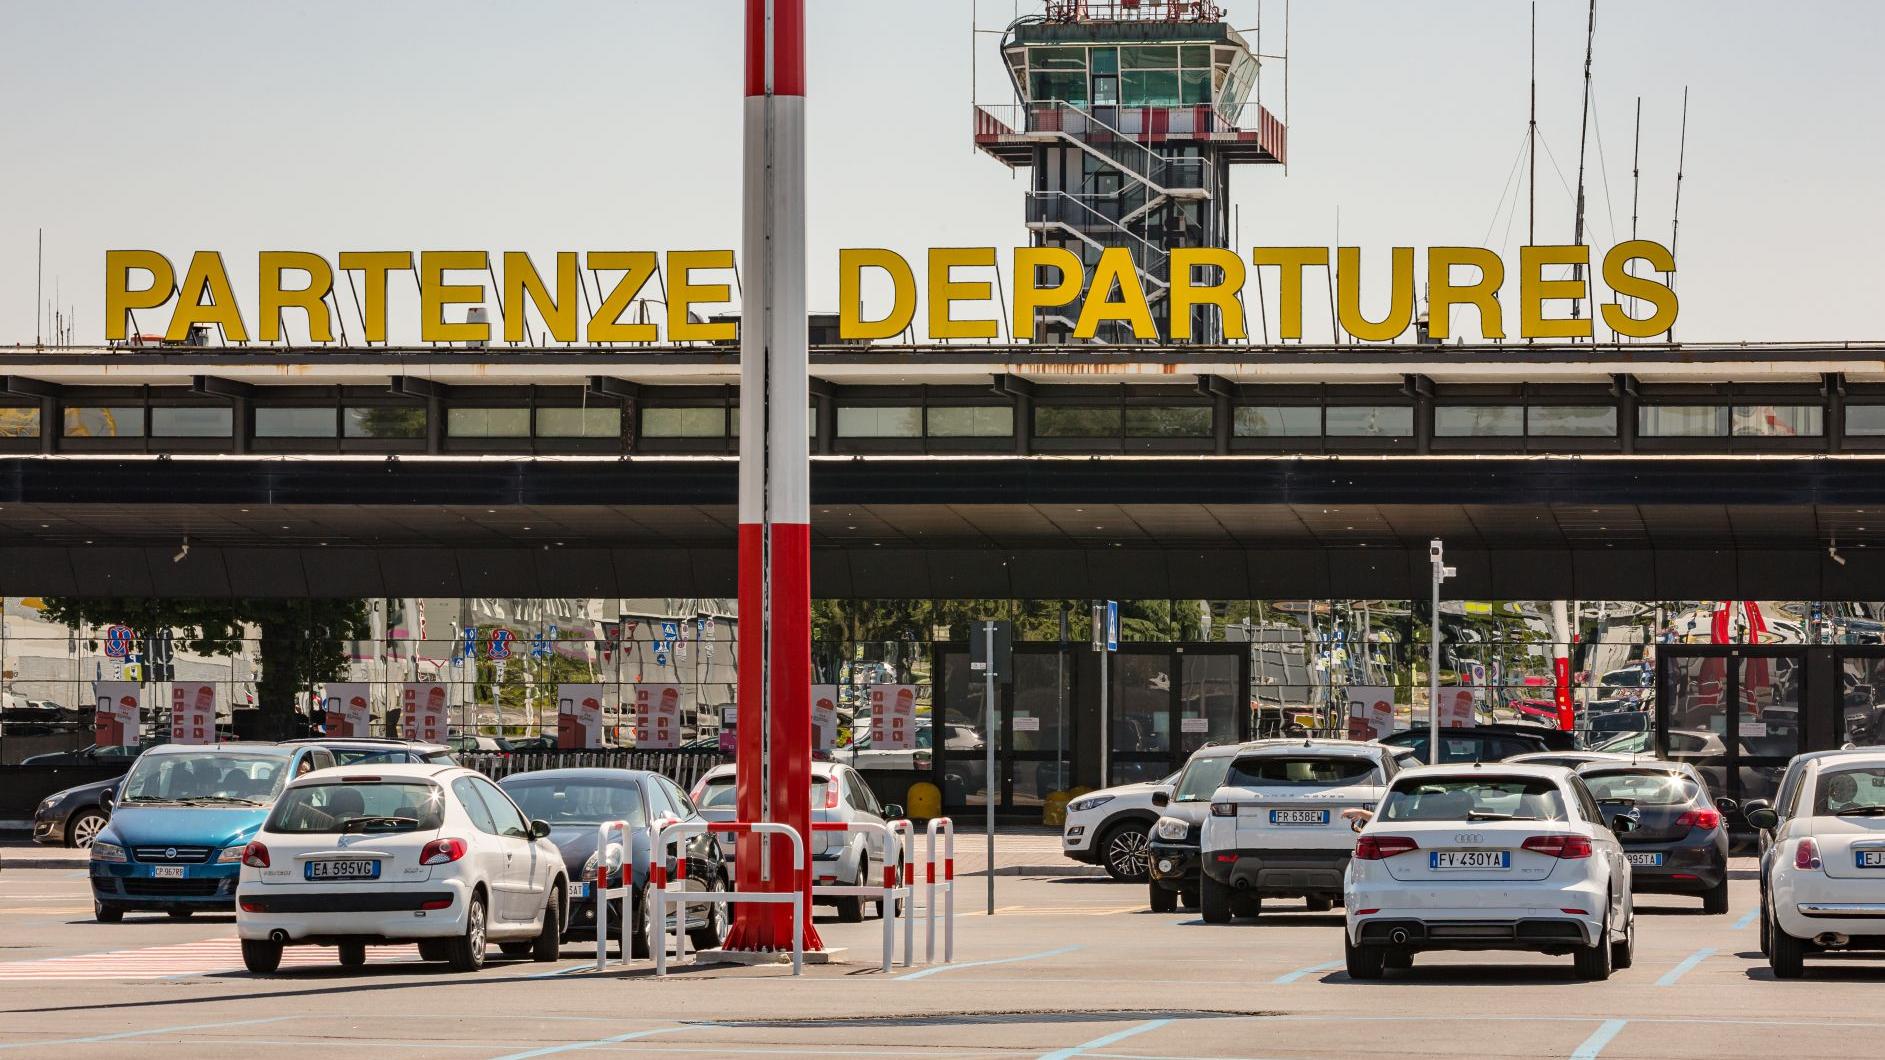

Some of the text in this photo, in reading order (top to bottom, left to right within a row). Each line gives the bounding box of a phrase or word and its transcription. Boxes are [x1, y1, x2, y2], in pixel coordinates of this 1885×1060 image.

[105, 239, 1680, 342] PARTENZE DEPARTURES
[1277, 811, 1324, 822] FR 638EW
[1438, 852, 1501, 866] FV 430YA
[1865, 852, 1882, 865] EJ
[314, 861, 371, 876] EA 595VG
